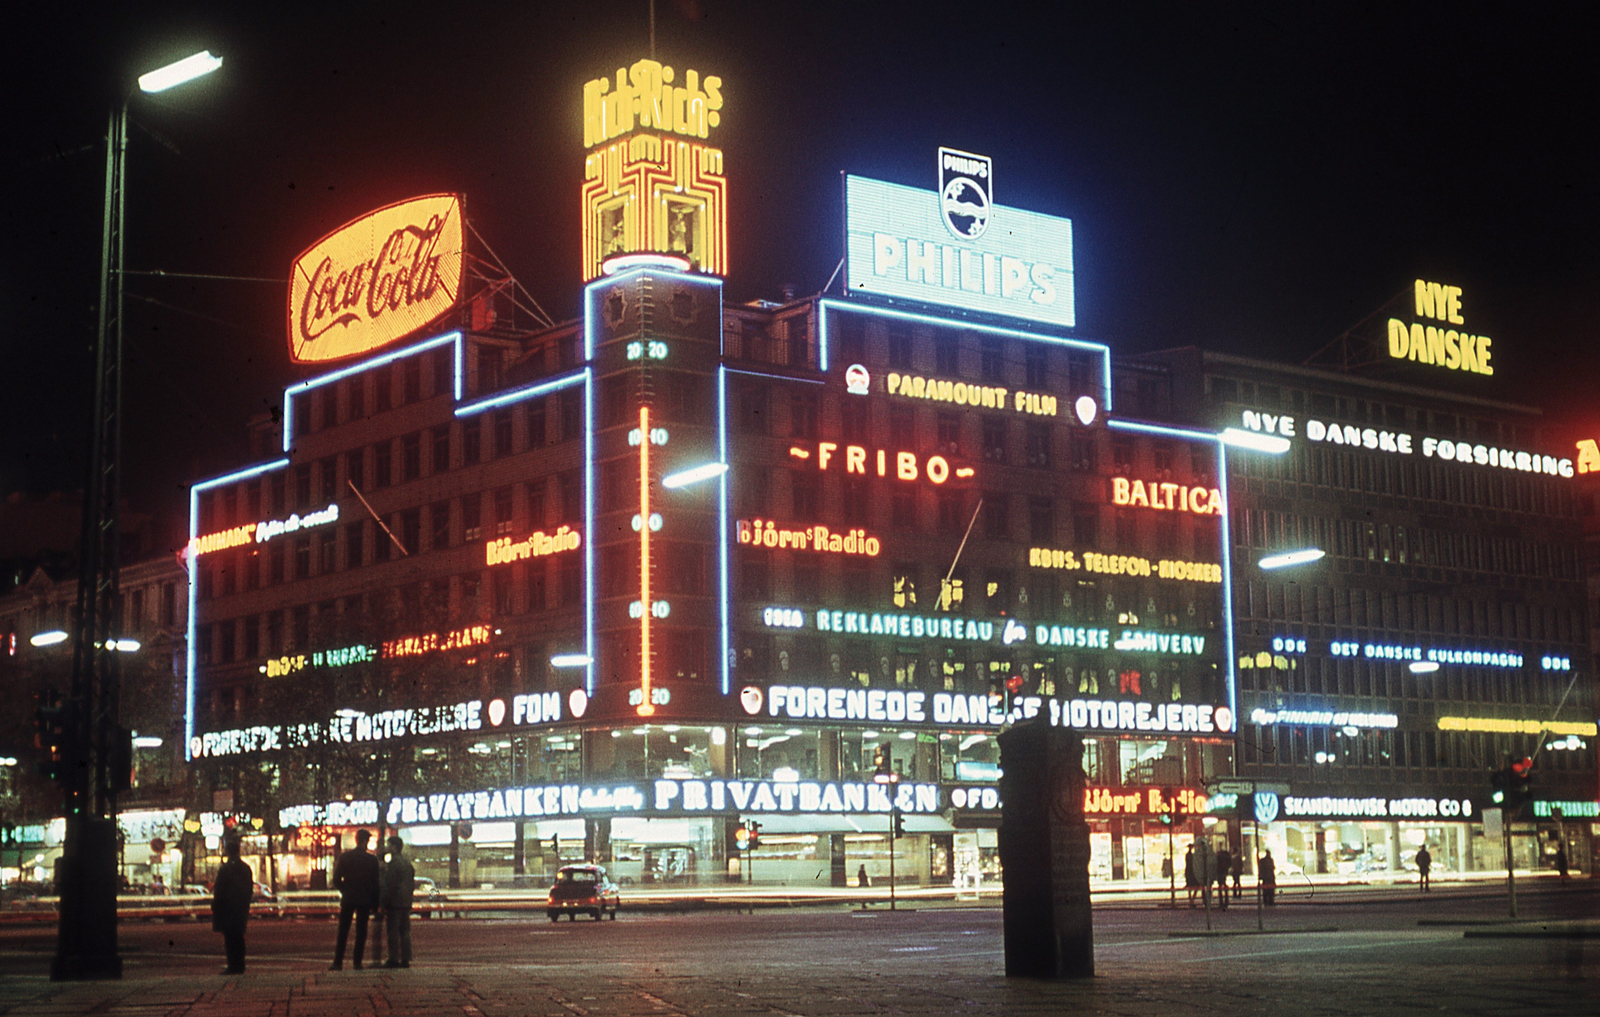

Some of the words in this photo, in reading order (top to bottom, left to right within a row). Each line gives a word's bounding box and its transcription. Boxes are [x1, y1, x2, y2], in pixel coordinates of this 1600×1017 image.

[943, 154, 988, 178] PHILIPS
[873, 230, 1057, 305] PHILIPS
[1414, 278, 1465, 325] NYE
[648, 340, 669, 360] 20
[1387, 317, 1494, 376] DANSKE
[887, 372, 1008, 409] PARAMOUNT
[1015, 390, 1058, 417] FILM
[818, 442, 950, 484] FRIBO
[1242, 410, 1296, 437] NYE
[1306, 419, 1413, 454] DANSKE
[1422, 437, 1575, 478] FORSIKRING
[1112, 477, 1224, 516] BALTICA
[813, 526, 880, 557] Radio
[816, 609, 994, 641] REKLAMEBUREAU
[1035, 625, 1110, 649] DANSKE
[1330, 641, 1359, 657] DET
[1364, 643, 1422, 661] DANSKE
[513, 691, 561, 725] FDM
[768, 685, 926, 722] FORENEDE
[386, 784, 579, 824] PRIVATBANKEN
[654, 780, 937, 812] PRIVATBANKEN
[967, 788, 1003, 810] FD
[1283, 797, 1388, 817] SKANDINAVISK
[1389, 799, 1438, 817] MOTOR
